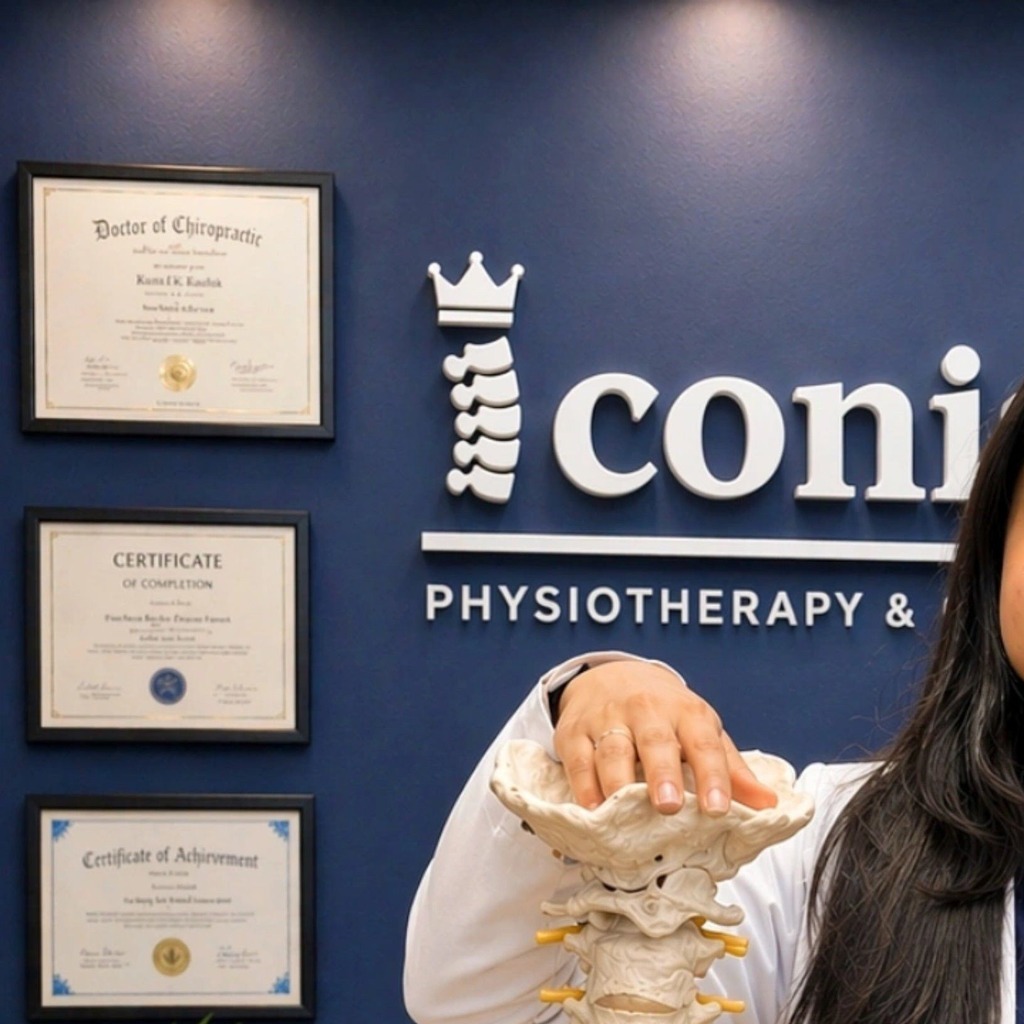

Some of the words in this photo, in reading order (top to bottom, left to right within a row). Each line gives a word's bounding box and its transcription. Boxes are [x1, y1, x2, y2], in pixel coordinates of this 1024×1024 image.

[92, 218, 147, 242] Doctor
[152, 215, 167, 234] of
[172, 215, 263, 247] Chiropractic
[112, 552, 223, 569] CERTIFICATE
[122, 579, 137, 589] OF
[141, 579, 213, 590] COMPLETION
[426, 584, 864, 627] PHYSIOTHERAPY
[885, 592, 916, 628] &
[82, 848, 152, 869] Certificate
[156, 846, 171, 863] of
